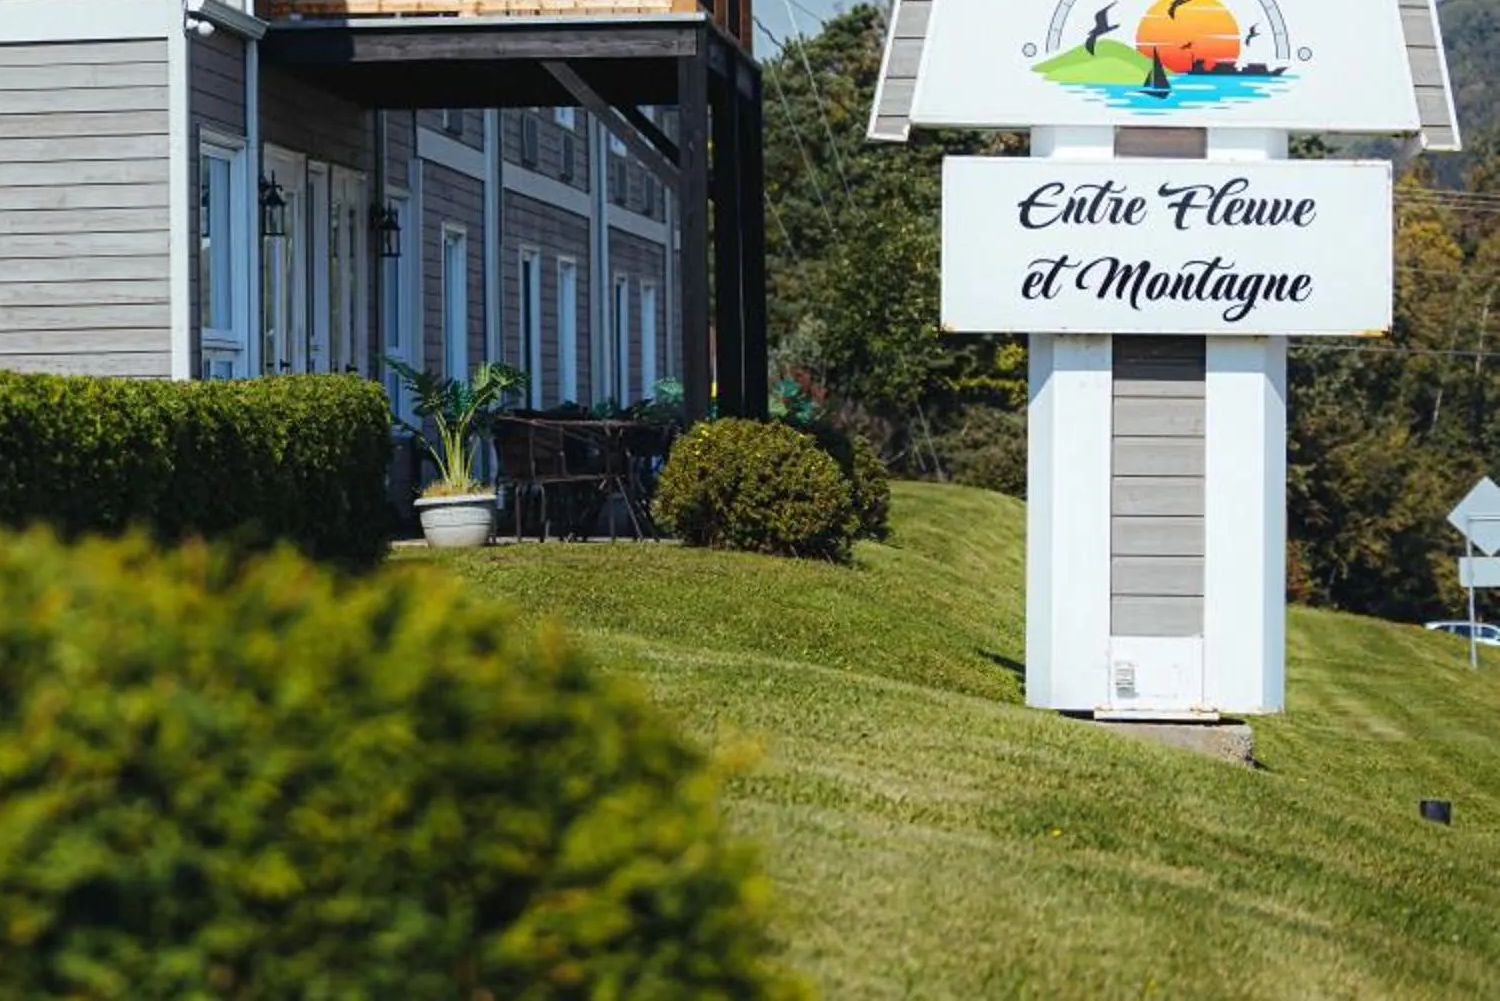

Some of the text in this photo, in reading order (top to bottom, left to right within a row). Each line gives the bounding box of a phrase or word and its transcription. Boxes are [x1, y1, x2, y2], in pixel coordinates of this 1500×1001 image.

[1018, 177, 1317, 231] Entre Fleuve
[1021, 254, 1313, 323] et Montagne
